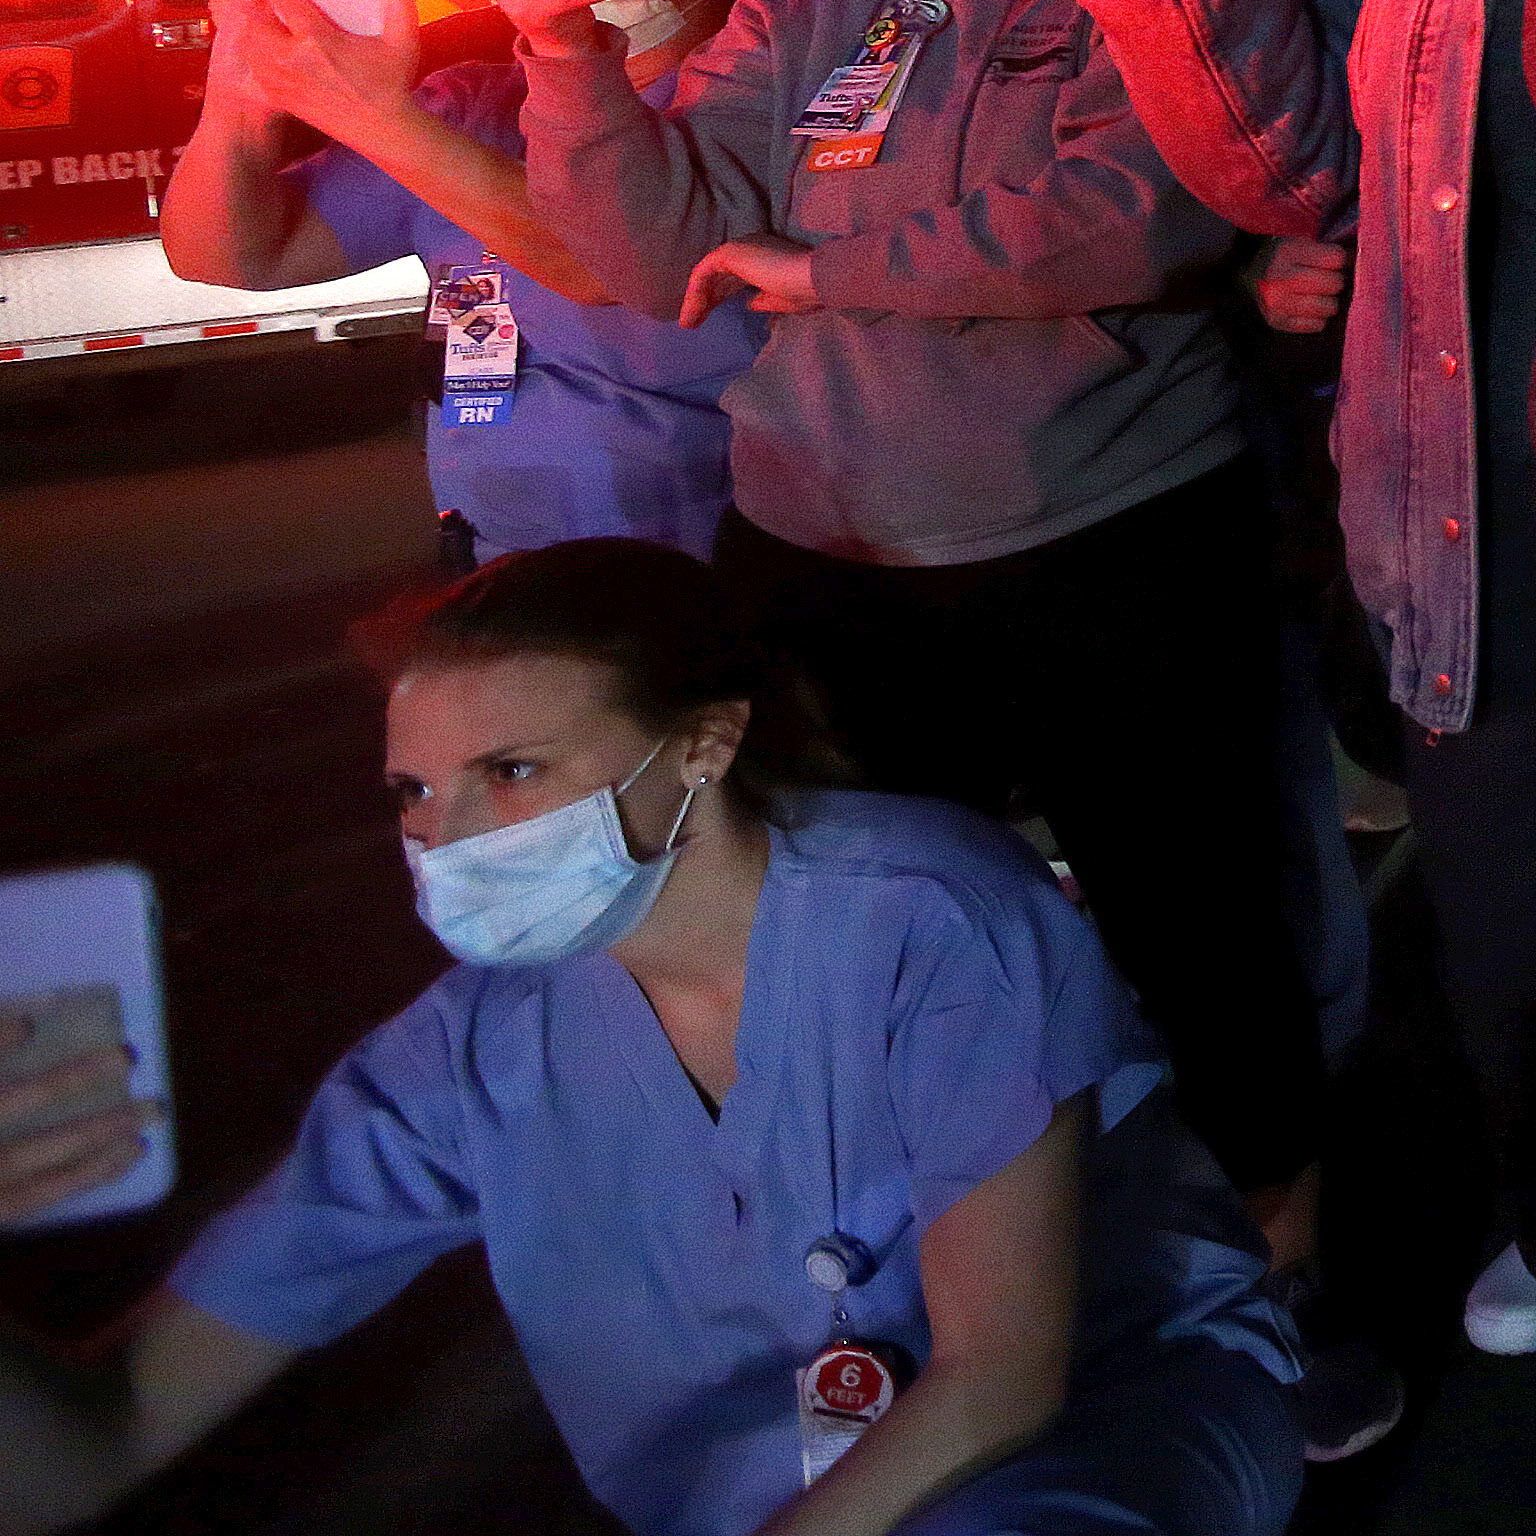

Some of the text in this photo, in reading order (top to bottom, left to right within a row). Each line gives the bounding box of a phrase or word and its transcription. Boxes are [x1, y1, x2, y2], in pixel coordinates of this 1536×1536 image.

[819, 93, 853, 102] Tufts
[52, 148, 165, 185] BACK
[814, 147, 873, 167] CCT
[450, 342, 486, 355] Tufts
[458, 406, 495, 424] RN
[840, 1362, 862, 1387] 6
[826, 1386, 868, 1405] FEET
